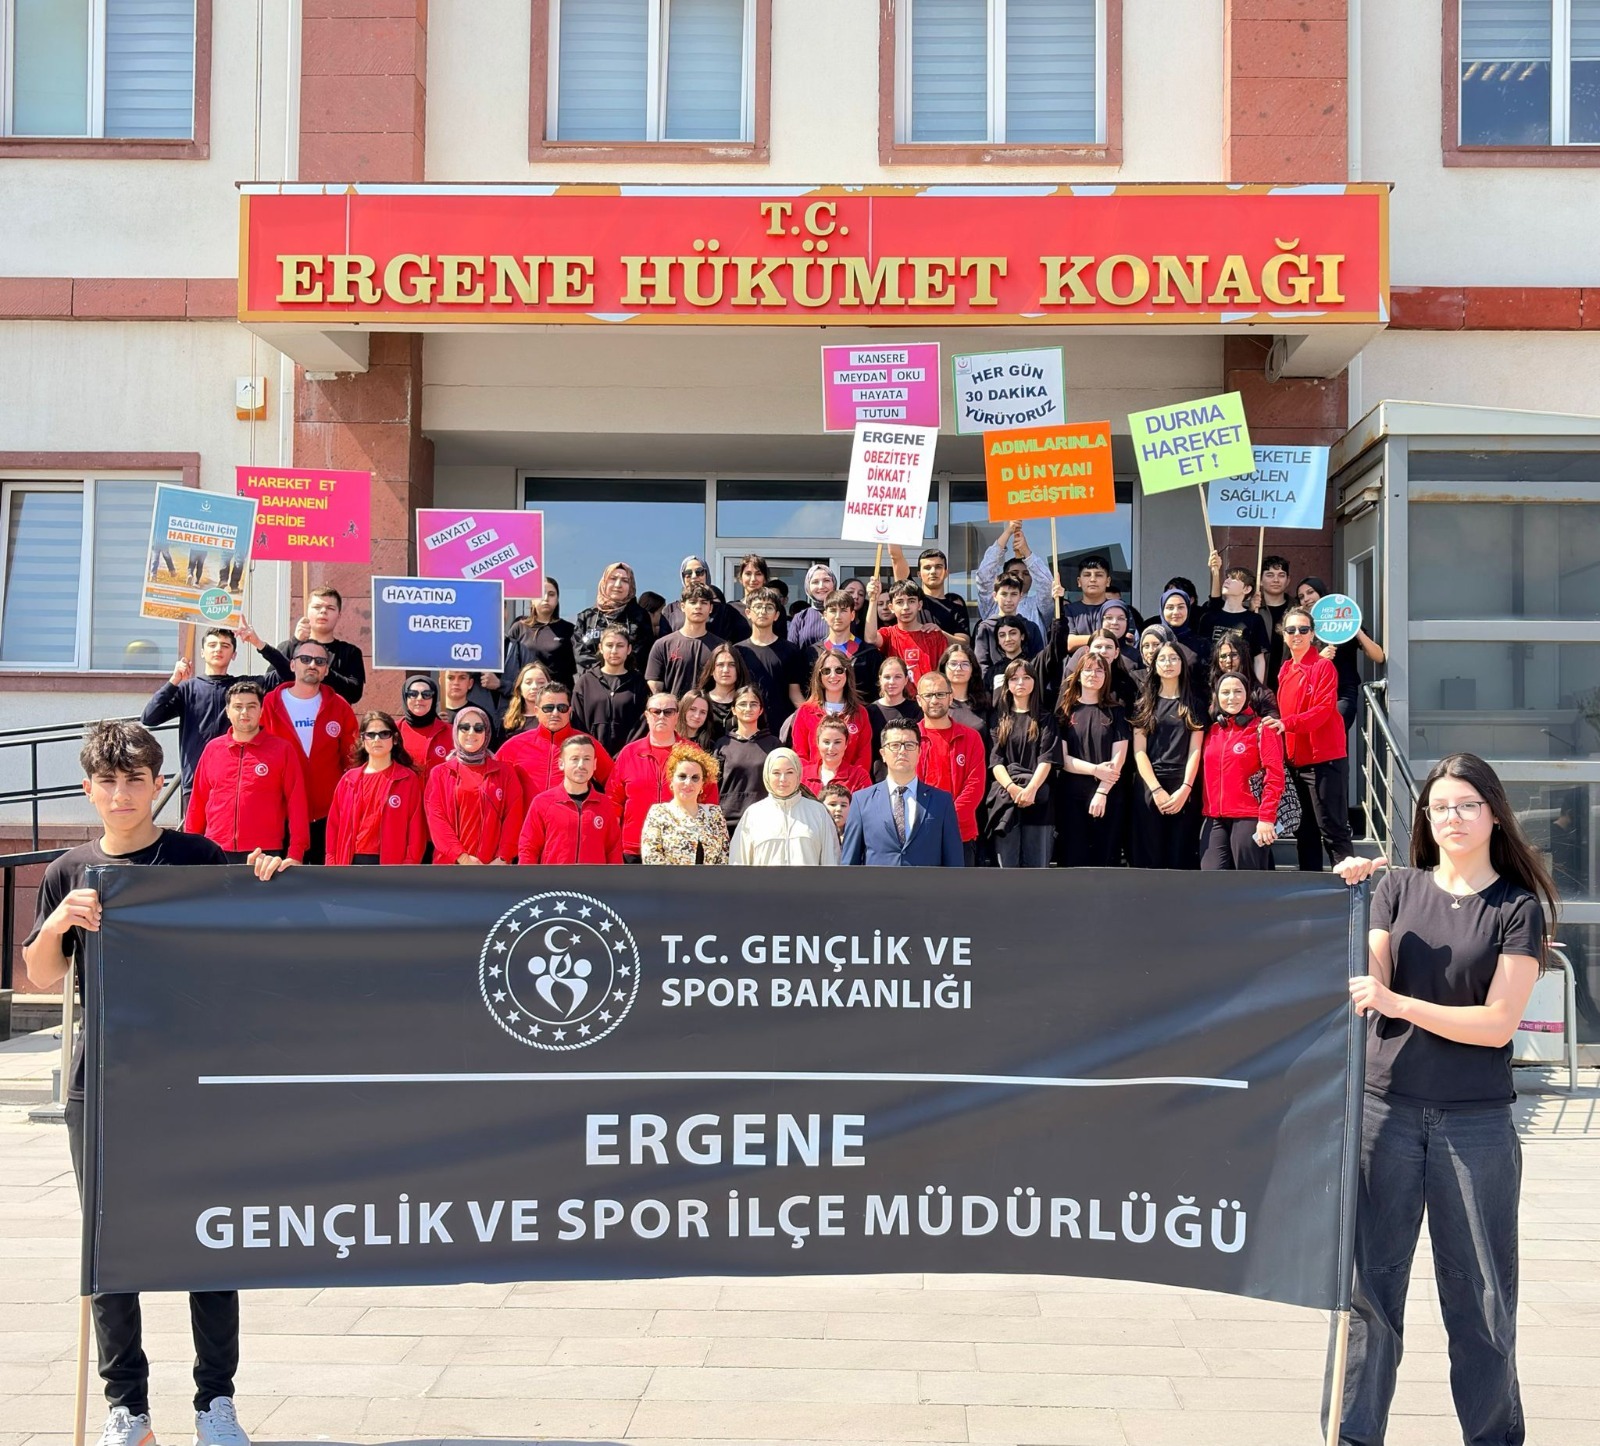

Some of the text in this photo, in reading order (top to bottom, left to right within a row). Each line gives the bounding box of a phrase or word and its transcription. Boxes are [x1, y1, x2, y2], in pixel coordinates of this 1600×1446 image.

[760, 202, 848, 237] T.C.
[275, 237, 1346, 307] ERGENE HÜKÜMET KONAĞI
[858, 353, 905, 363] KANSERE
[840, 370, 920, 382] MEYDAN OKU
[971, 363, 1044, 385] HER GÜN
[860, 390, 903, 400] HAYATA
[965, 384, 1048, 403] 30 DAKİKA
[862, 409, 899, 418] TUTUN
[964, 399, 1056, 425] YÜRÜYORUZ
[1145, 404, 1225, 434] DURMA
[862, 431, 925, 446] ERGENE
[990, 434, 1107, 456] ADIMLARINLA
[1142, 424, 1243, 462] HAREKET
[863, 448, 920, 466] OBEZİTEYE
[1178, 454, 1205, 476] ET
[1253, 450, 1312, 464] EKETLE
[1001, 461, 1092, 482] DÜNYANI
[248, 476, 336, 491] HAREKET ET
[262, 496, 328, 510] BAHANENİ
[867, 486, 907, 502] YAŞAMA
[1220, 487, 1296, 503] SAĞLIKLA
[847, 501, 893, 517] HAREKET
[170, 517, 236, 537] SAĞLIĞIN İÇİN
[256, 513, 305, 528] GERİDE
[168, 531, 235, 549] HAREKET ET
[431, 521, 471, 546] HAYATI
[471, 532, 491, 548] SEV
[470, 547, 515, 576] KANSERİ
[512, 560, 535, 576] YEN
[387, 589, 454, 602] HAYATINA
[1334, 606, 1352, 619] 10
[413, 617, 470, 630] HAREKET
[454, 647, 479, 658] KAT
[661, 930, 972, 972] T.C. GENÇLİK VE
[661, 973, 972, 1010] SPOR BAKANLIĞI
[585, 1114, 866, 1167] ERGENE
[195, 1185, 1248, 1259] GENÇLİK VE SPOR İLÇE MÜDÜRLÜĞÜ
